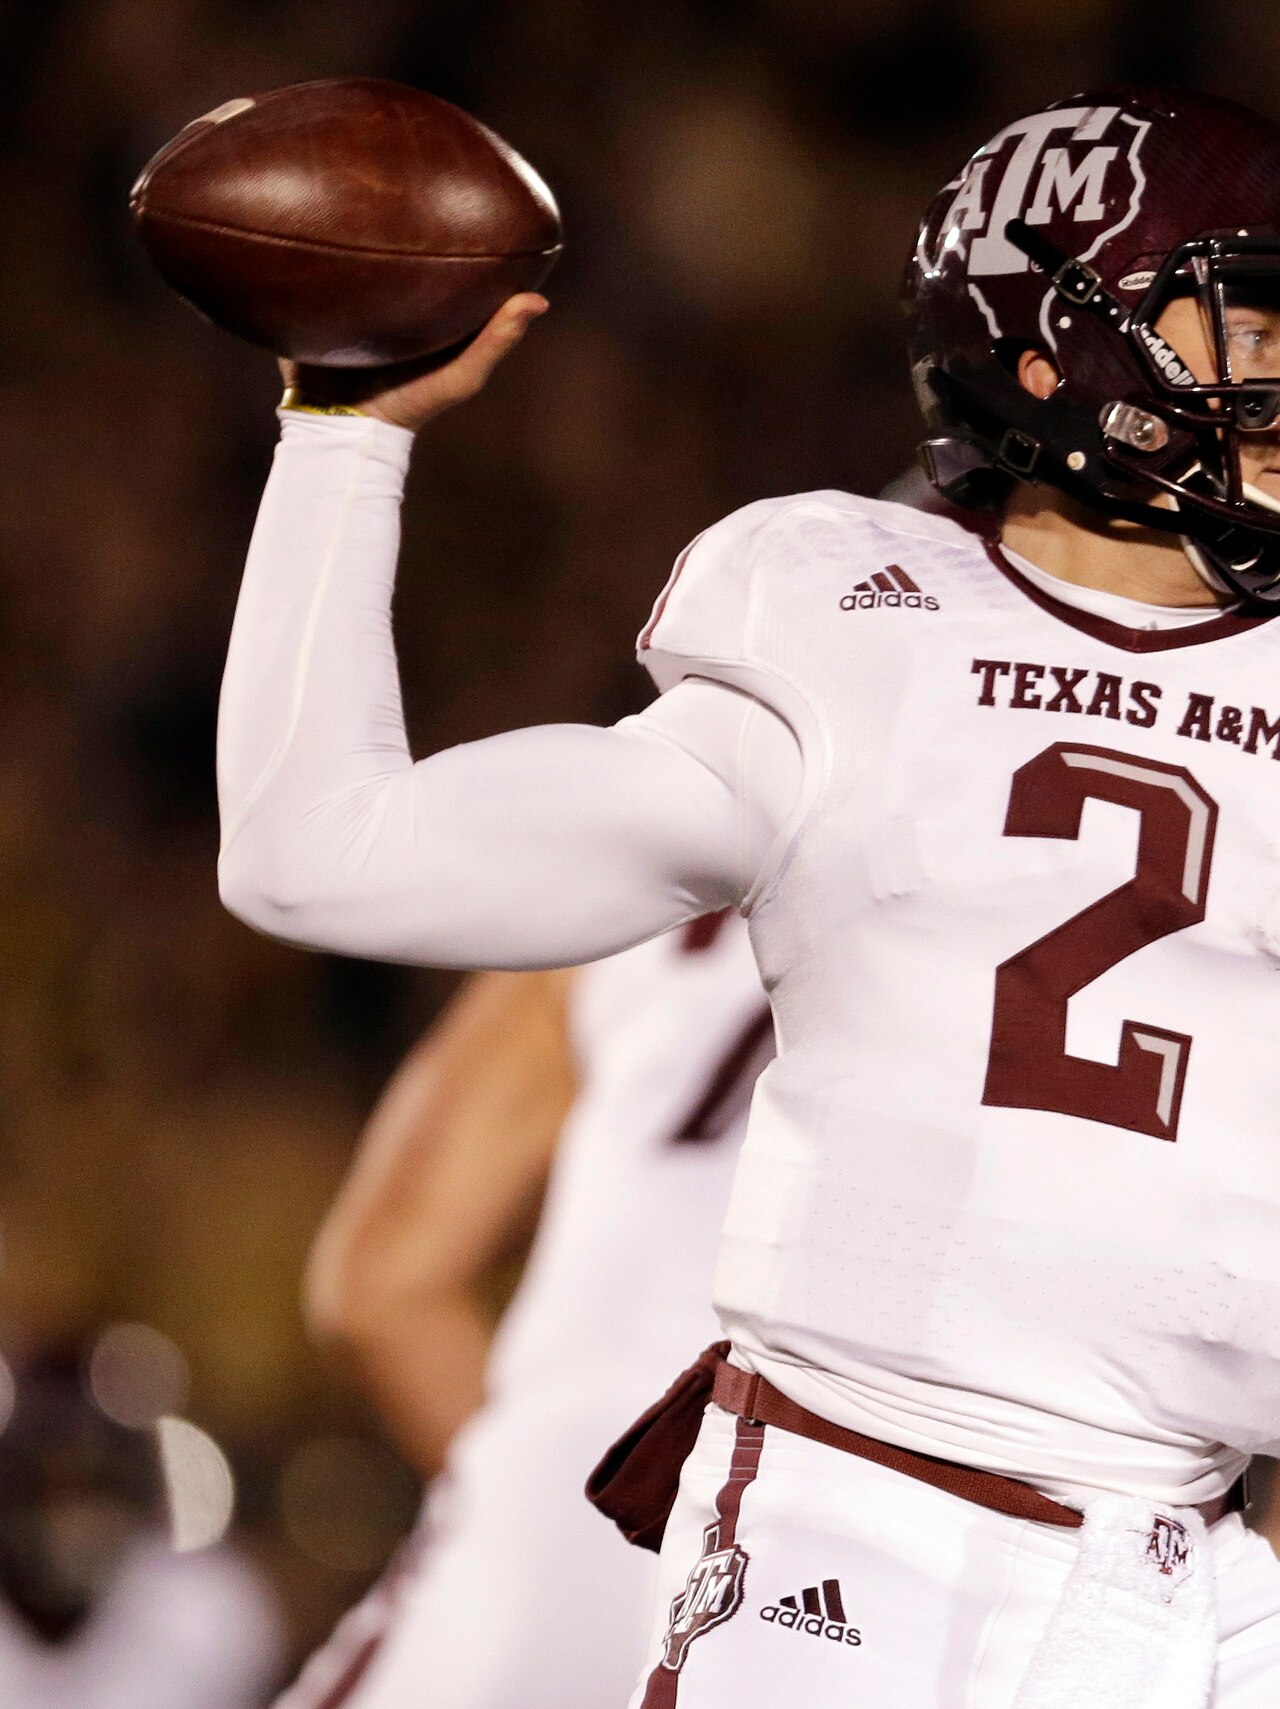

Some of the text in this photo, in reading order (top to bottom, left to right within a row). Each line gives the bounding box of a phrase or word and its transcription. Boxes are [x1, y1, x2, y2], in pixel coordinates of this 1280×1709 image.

[839, 589, 940, 611] adidas
[970, 658, 1163, 729] TEXAS
[981, 741, 1219, 1142] 2
[759, 1604, 863, 1647] adidas
